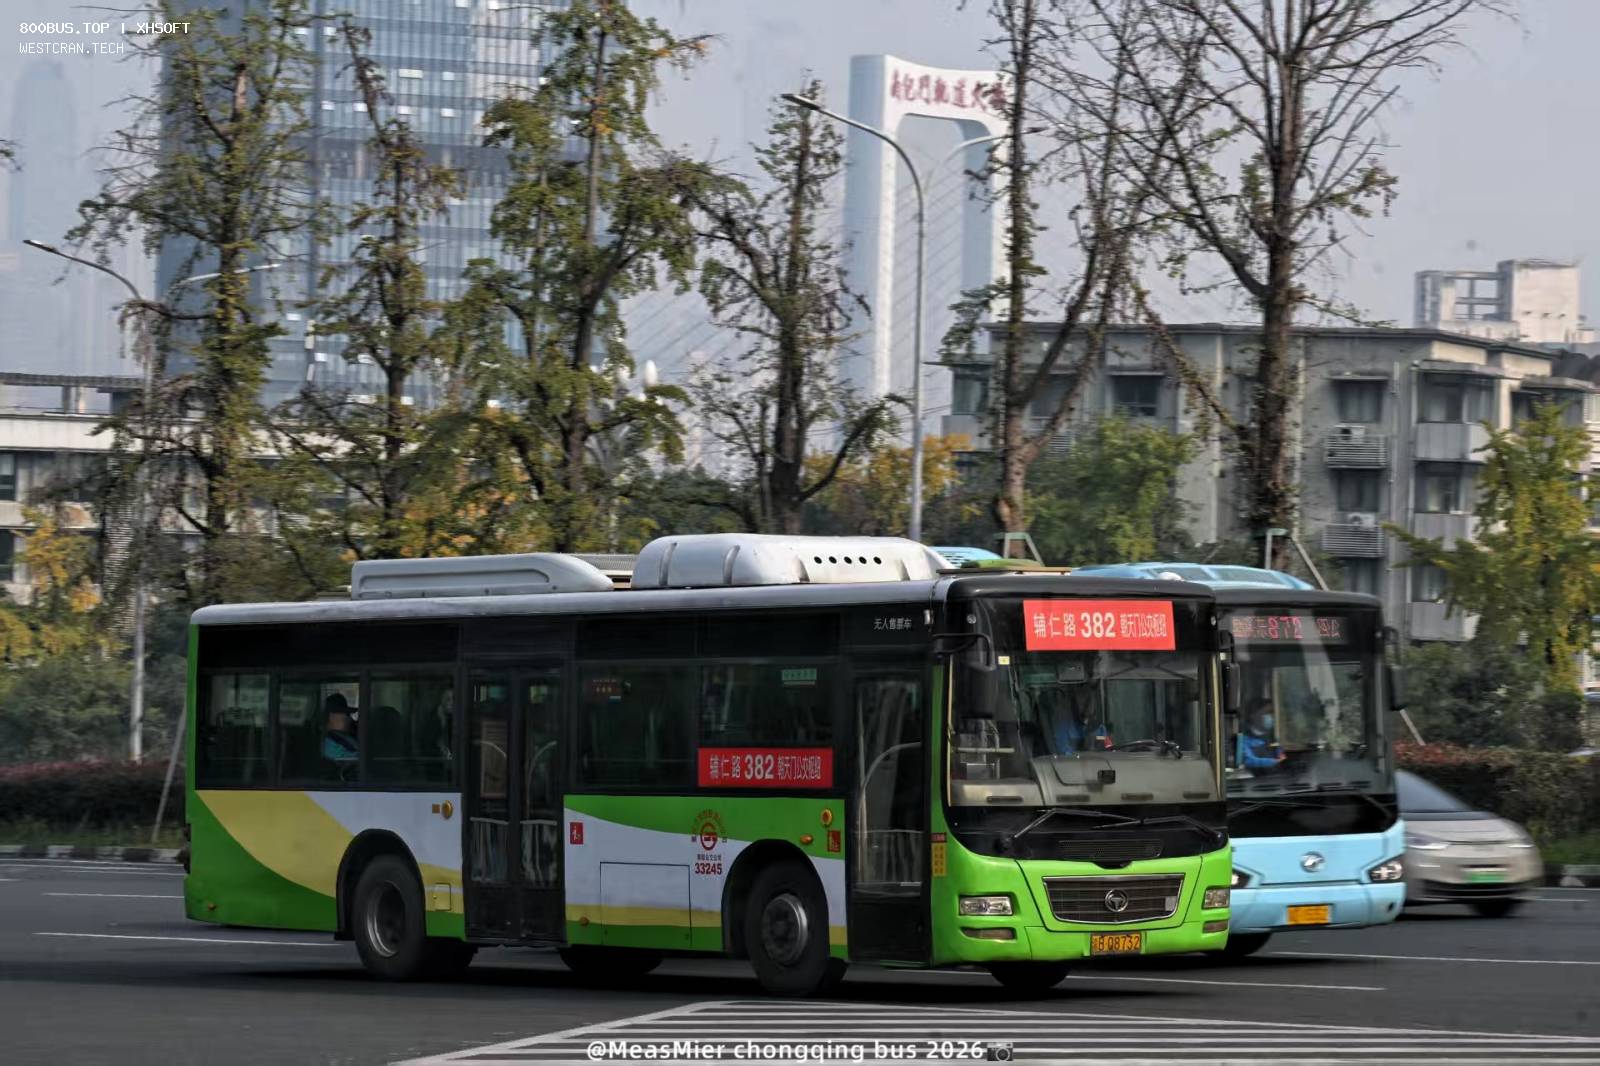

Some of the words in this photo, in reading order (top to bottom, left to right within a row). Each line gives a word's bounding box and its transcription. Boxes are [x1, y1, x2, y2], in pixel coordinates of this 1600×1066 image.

[873, 617, 912, 630] 无人售票车
[1080, 612, 1116, 638] 382
[744, 754, 774, 780] 382
[694, 862, 722, 875] 33245
